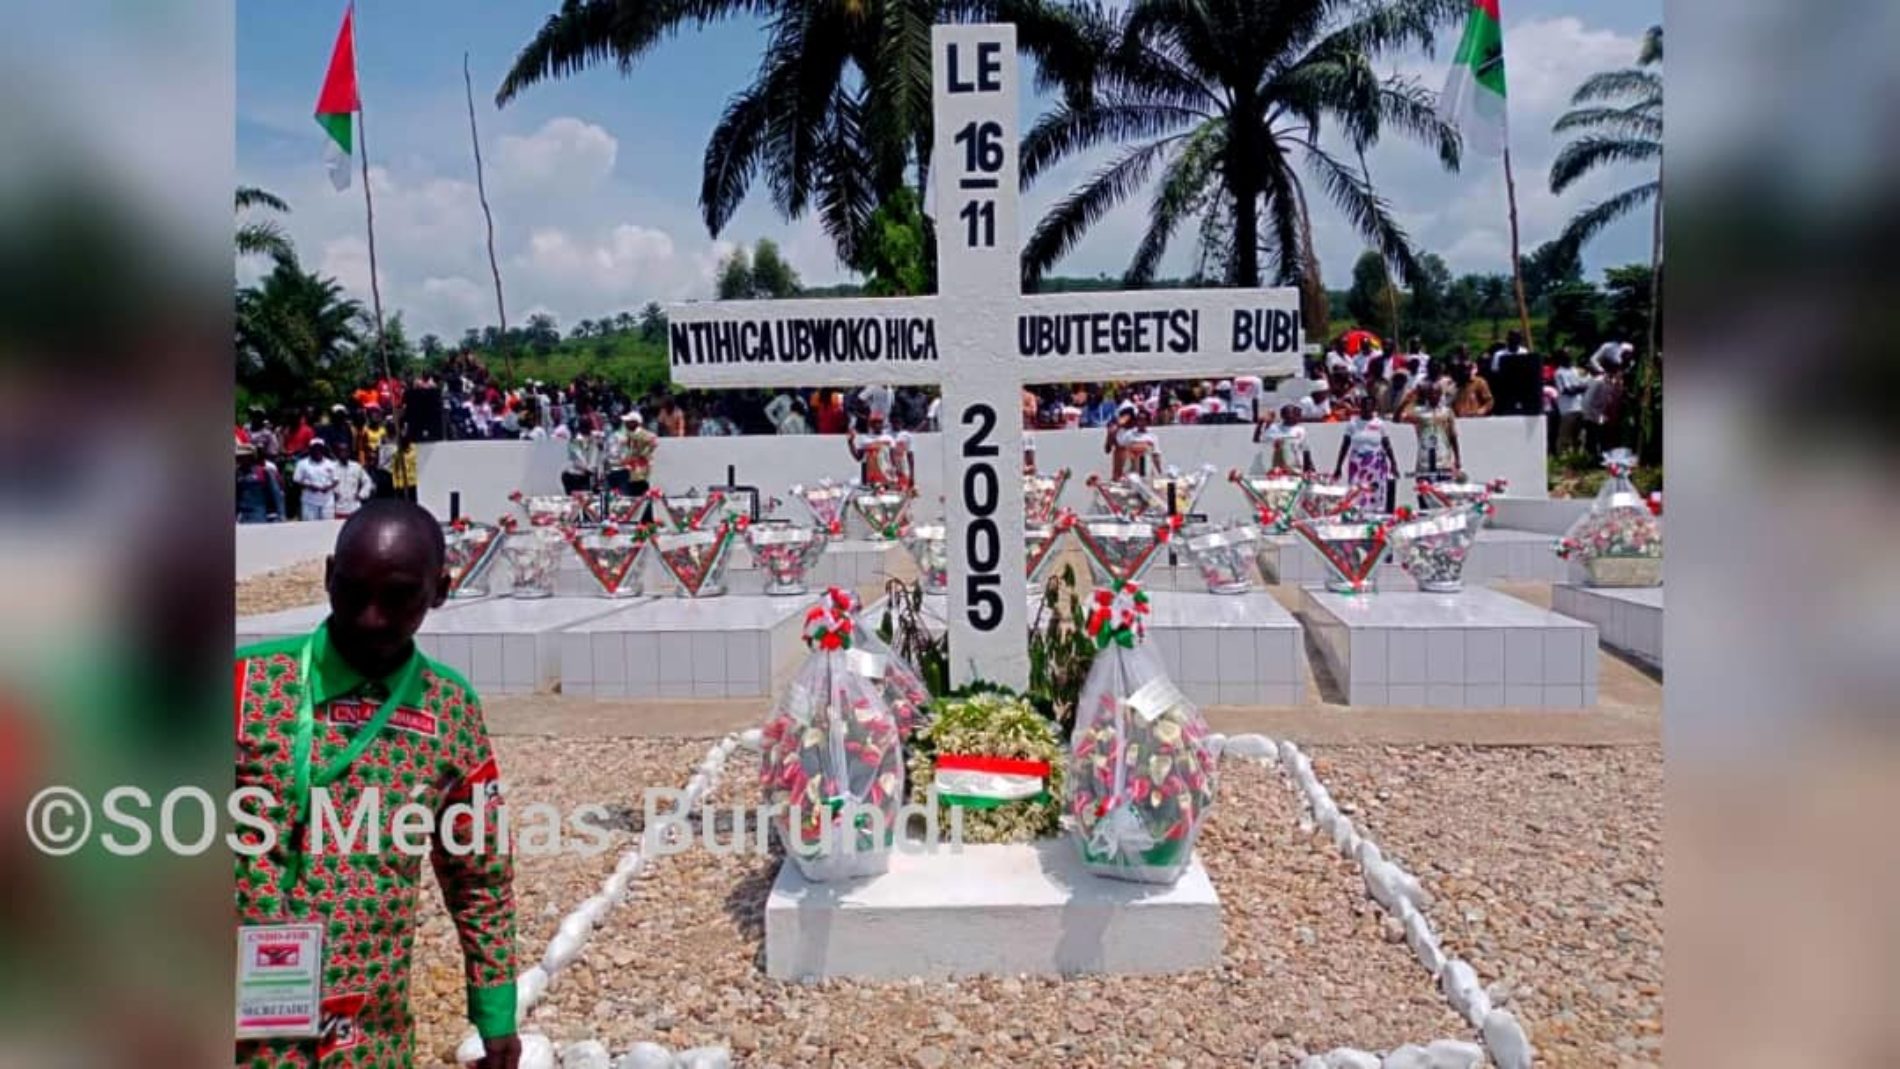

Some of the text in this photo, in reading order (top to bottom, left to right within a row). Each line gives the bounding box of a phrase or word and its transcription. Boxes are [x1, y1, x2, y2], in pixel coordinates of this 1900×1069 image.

[946, 42, 1001, 93] LE
[954, 121, 1004, 172] 16
[959, 200, 995, 247] 11
[670, 308, 1299, 366] NTIHICA UBWOKO HICA UBUTEGETSI BUBI
